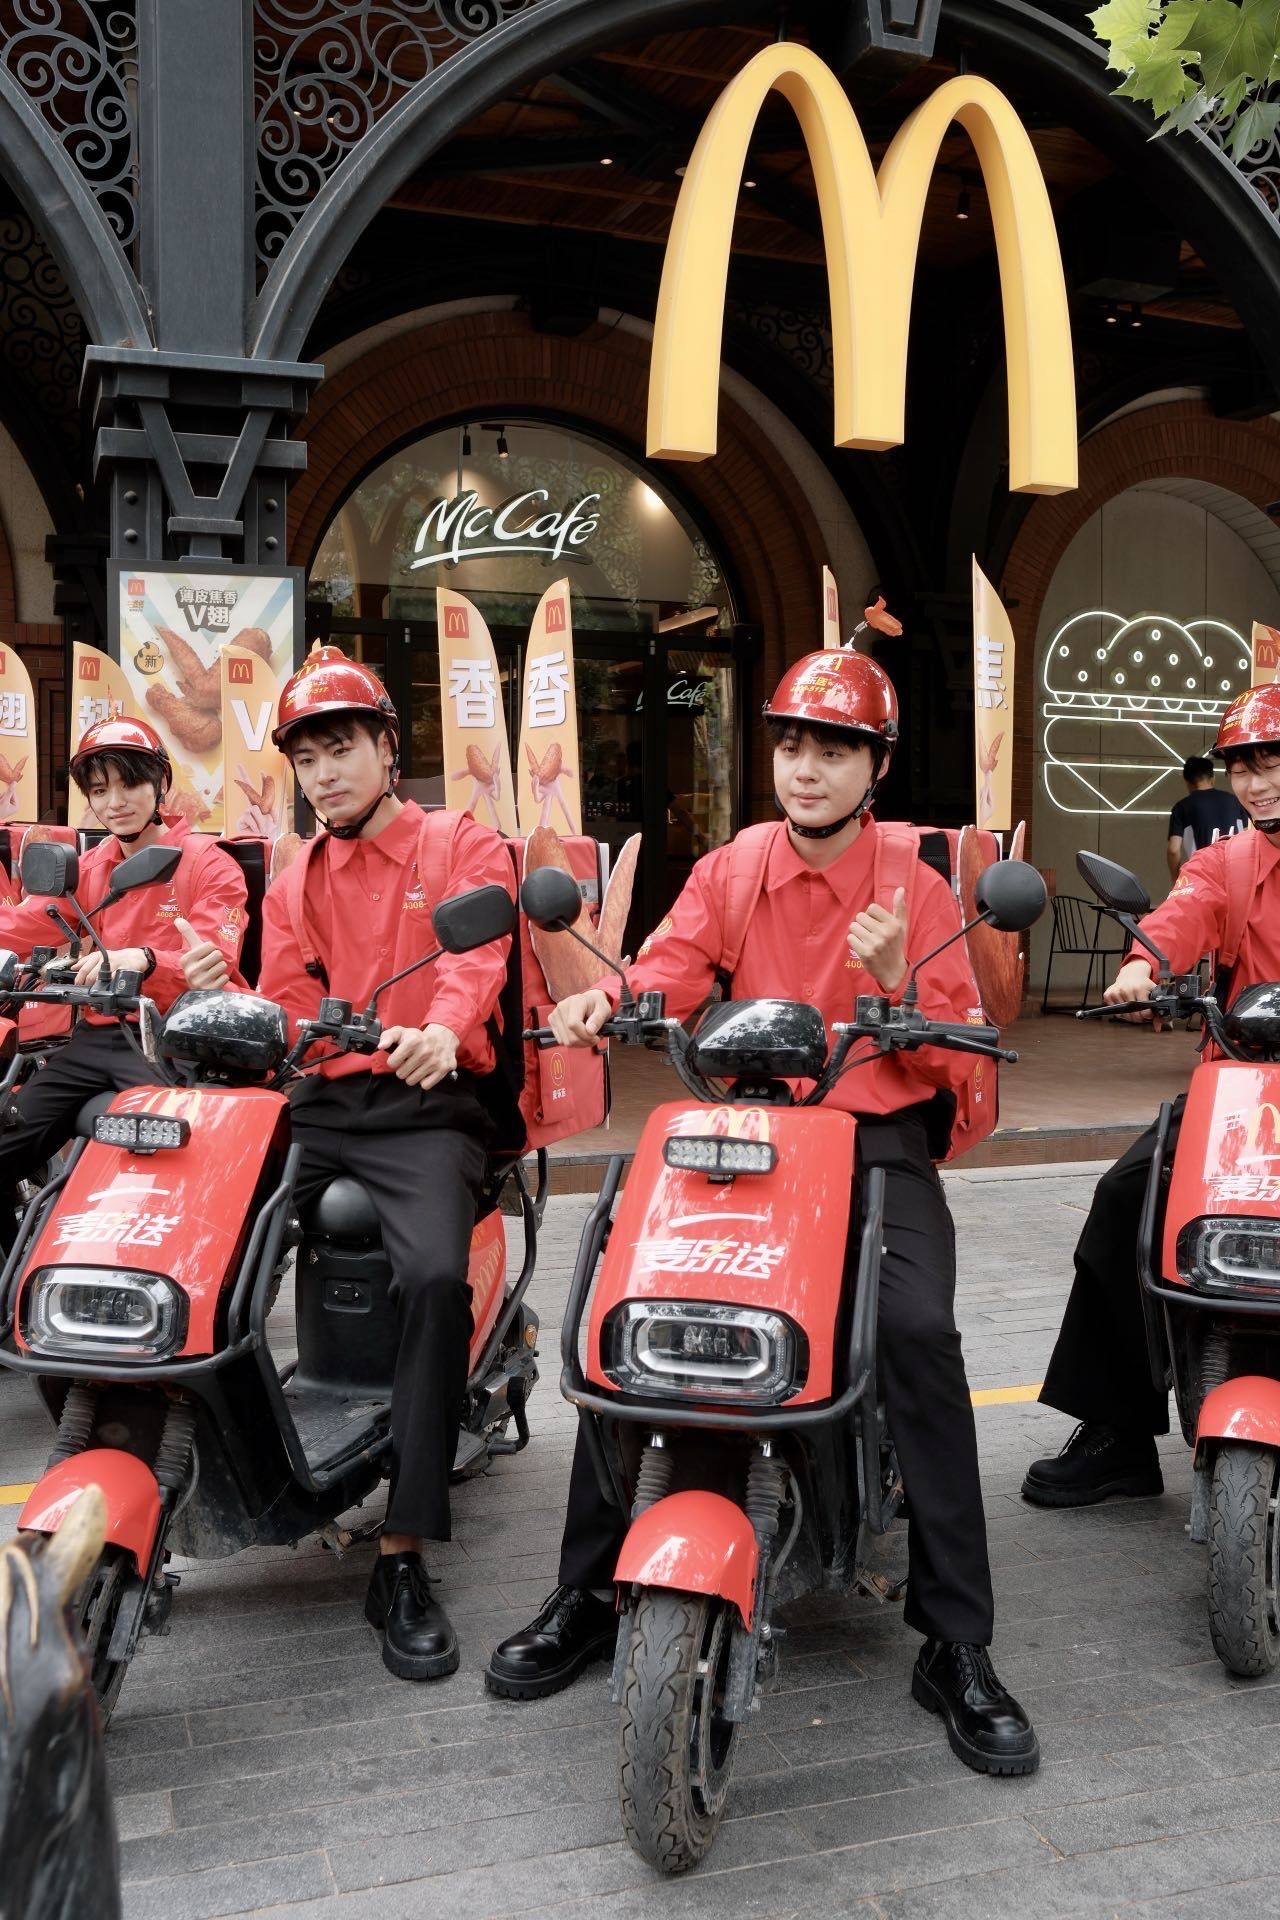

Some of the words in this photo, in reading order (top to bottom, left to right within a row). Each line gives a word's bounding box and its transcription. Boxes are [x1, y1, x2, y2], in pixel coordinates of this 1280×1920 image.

[411, 489, 600, 567] McCafé
[178, 588, 238, 605] 薄皮焦香
[187, 604, 231, 627] V翅
[145, 655, 157, 668] 新
[448, 658, 497, 728] 香
[528, 650, 570, 728] 香
[667, 679, 707, 708] Café
[229, 700, 273, 752] V
[843, 960, 865, 969] 400
[630, 1236, 787, 1280] 麦乐送
